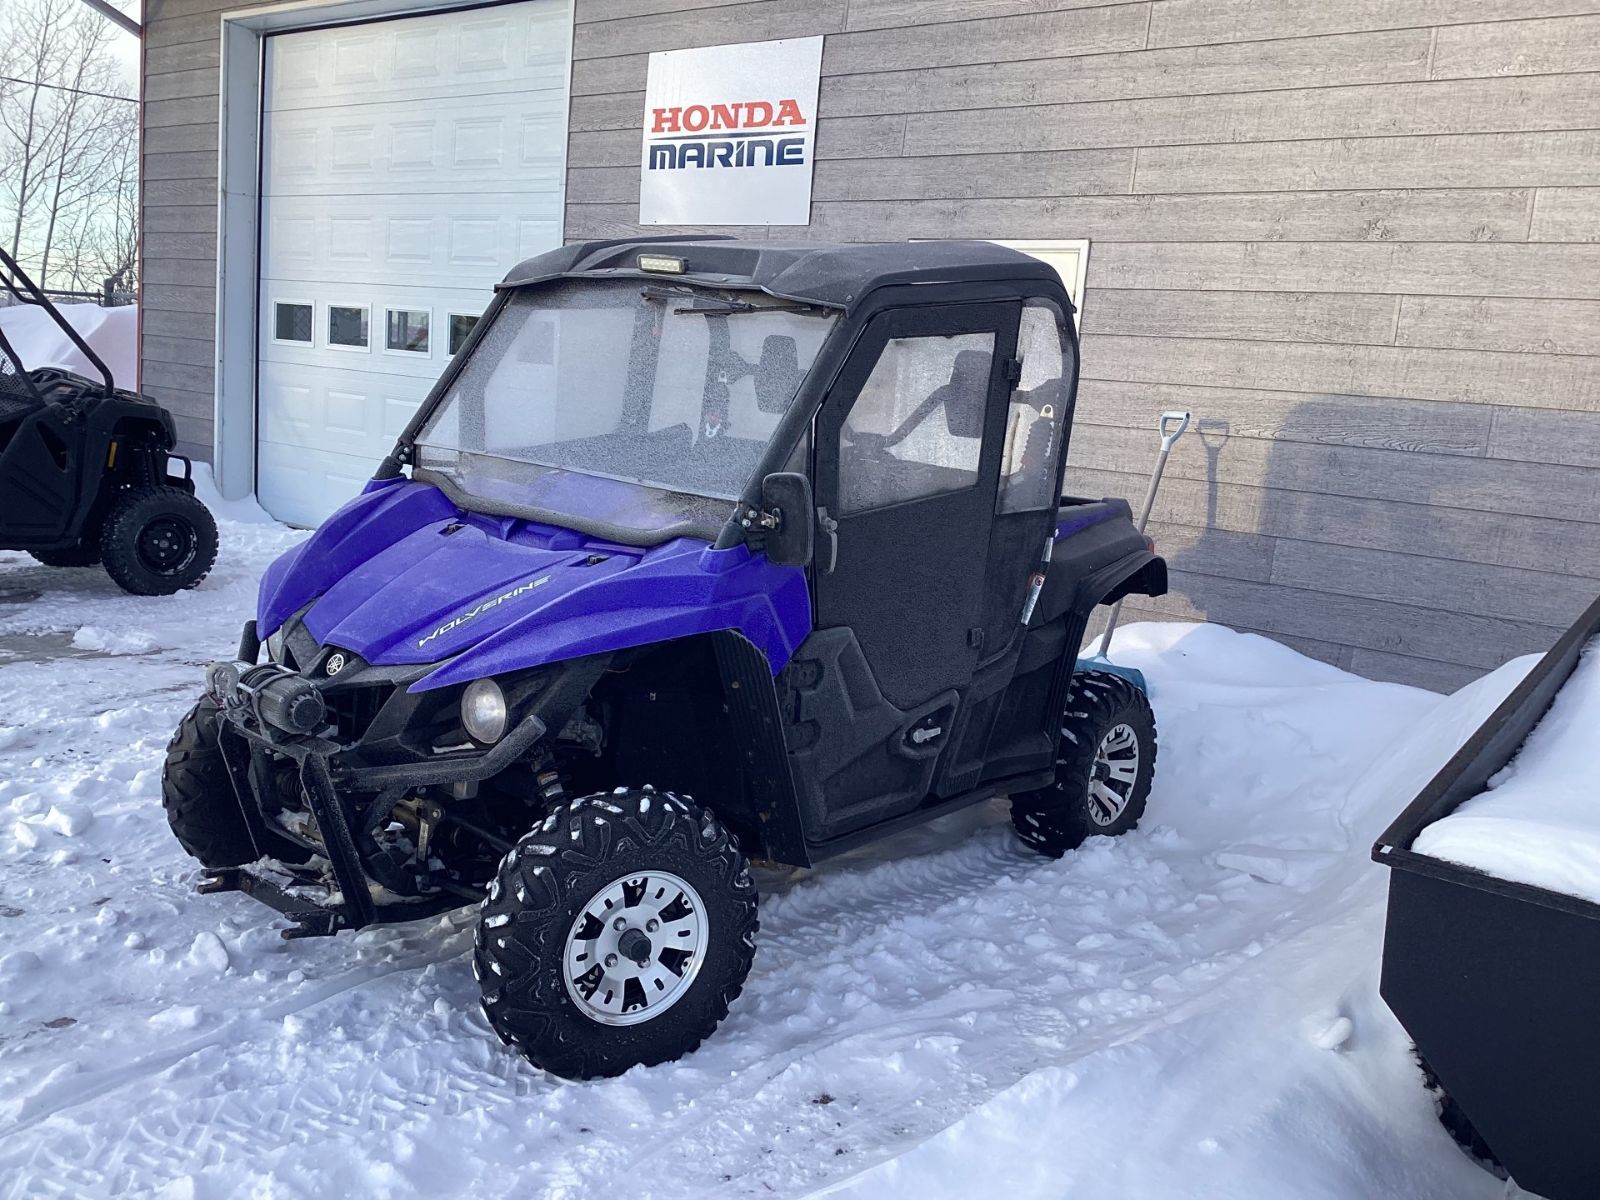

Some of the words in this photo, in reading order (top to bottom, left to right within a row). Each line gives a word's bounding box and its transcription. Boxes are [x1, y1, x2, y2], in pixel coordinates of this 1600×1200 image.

[651, 99, 806, 133] HONDA
[649, 138, 805, 170] MARINE
[418, 575, 551, 648] WOLVERINE
